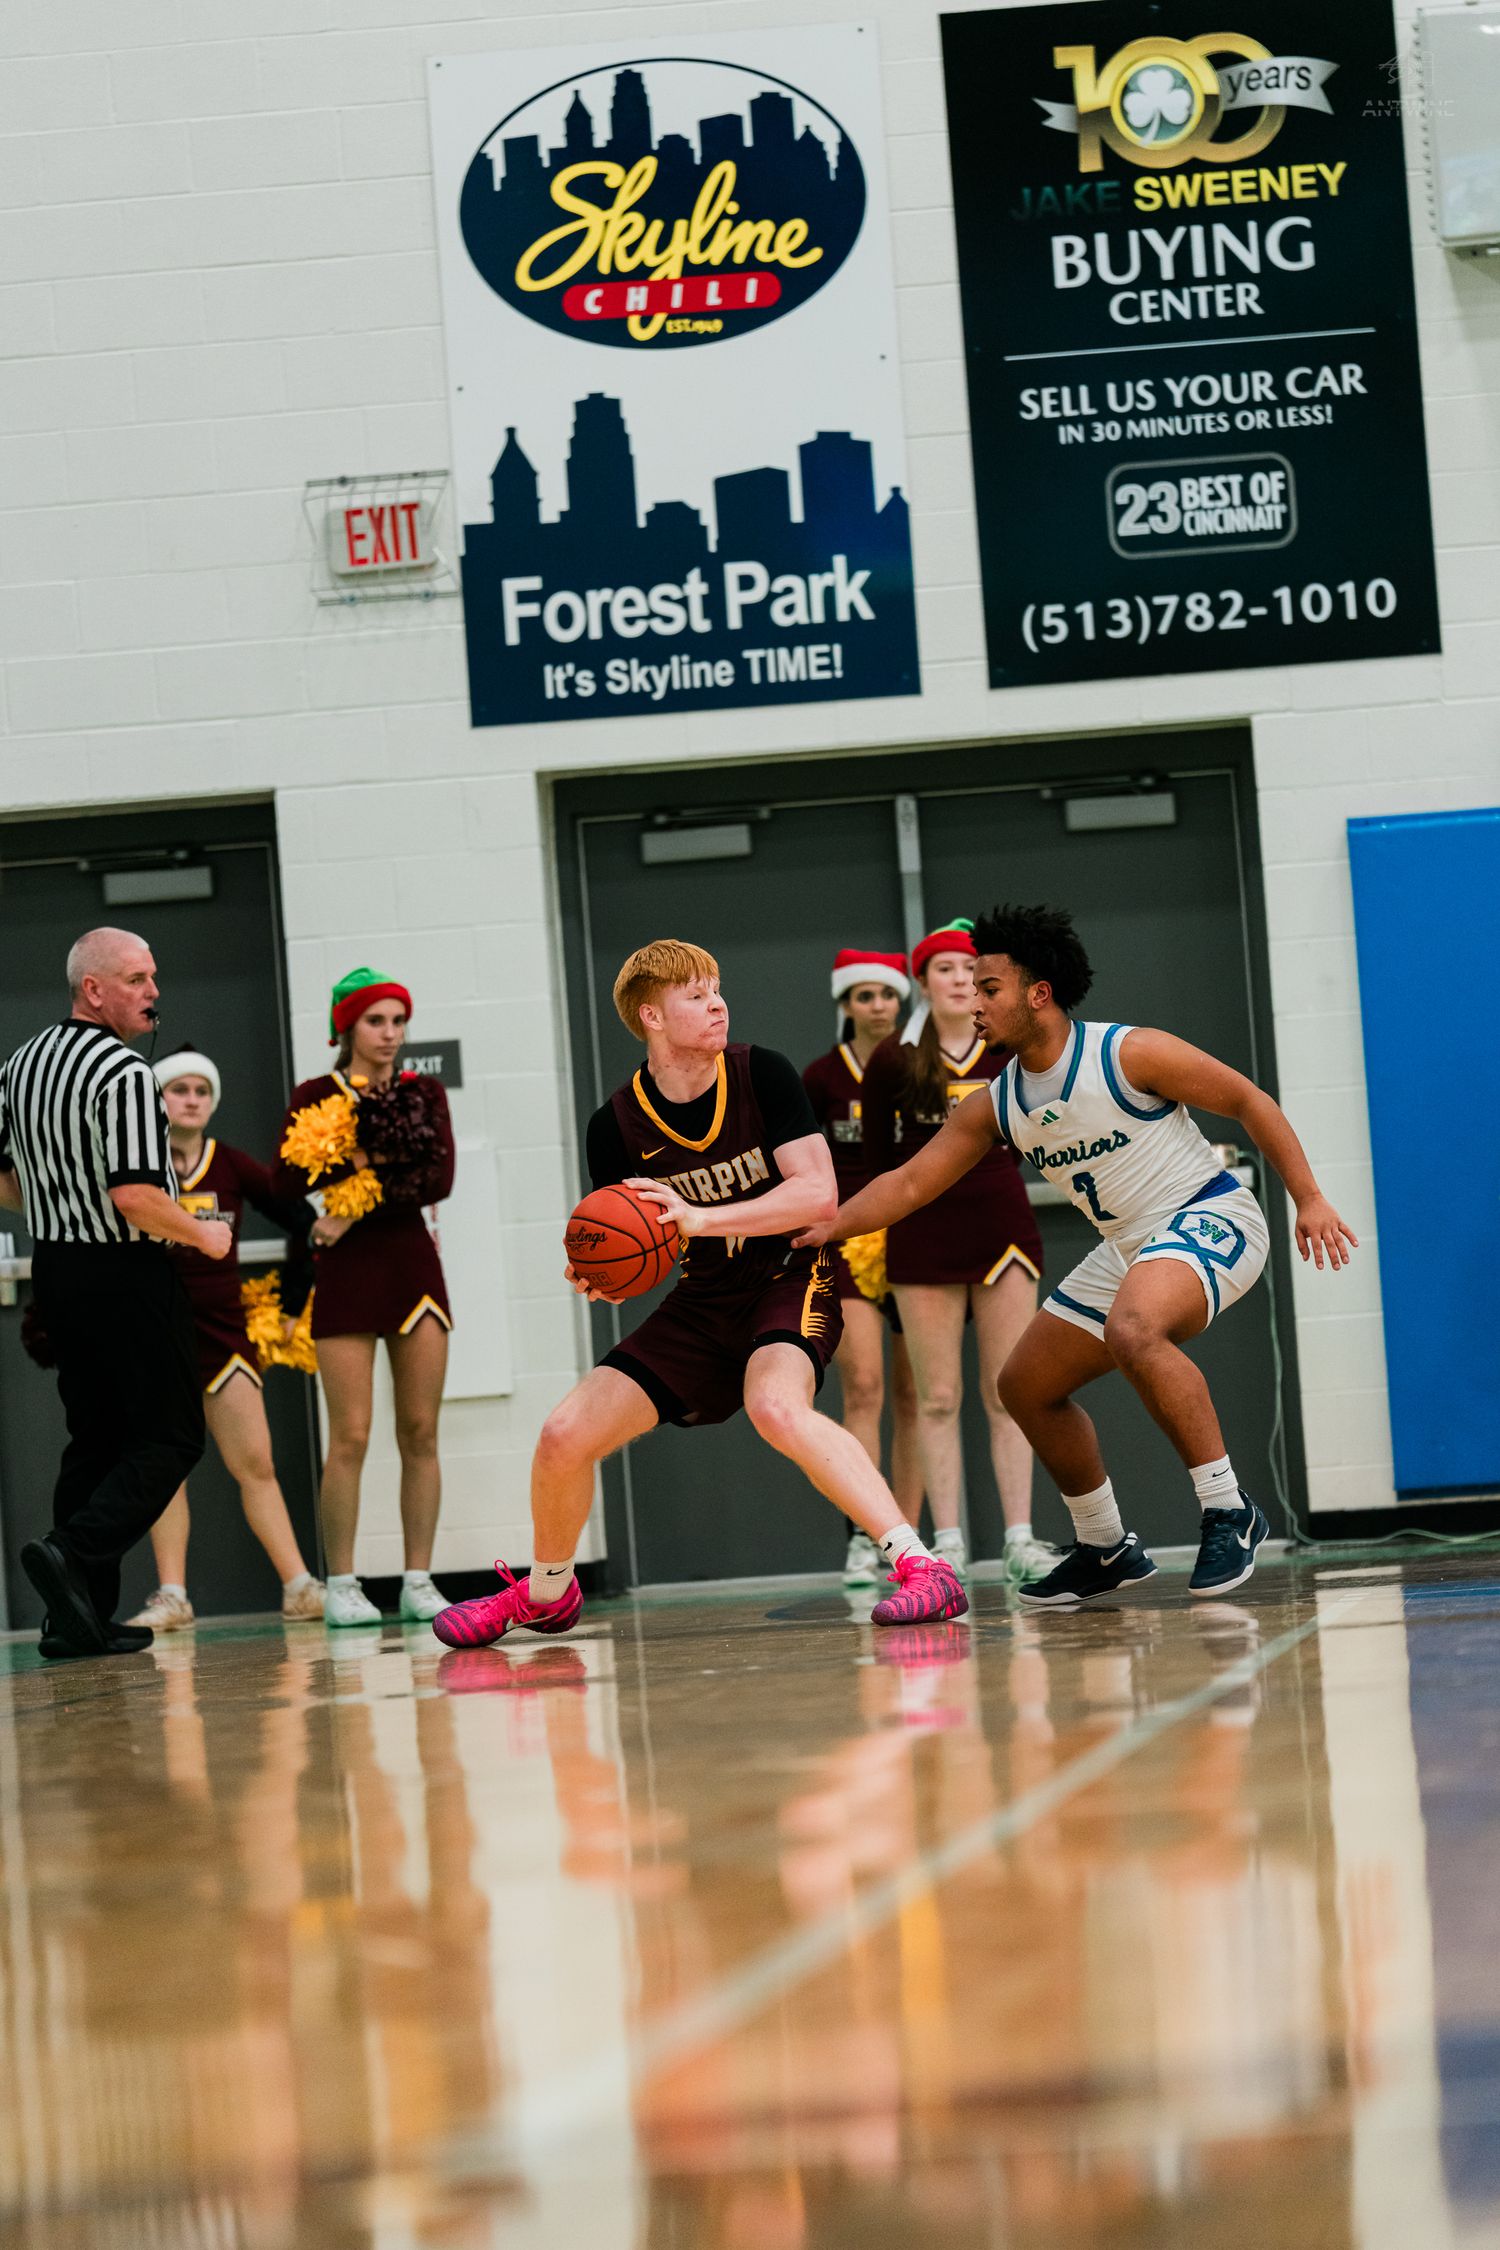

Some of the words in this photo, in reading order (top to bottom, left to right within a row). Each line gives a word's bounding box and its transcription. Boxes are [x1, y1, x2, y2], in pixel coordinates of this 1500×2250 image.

[1226, 61, 1313, 102] years
[1009, 180, 1122, 221] JAKE
[1133, 161, 1348, 212] SWEENEY
[515, 155, 824, 341] Skyline
[1050, 215, 1317, 290] BUYING
[583, 277, 759, 315] CHILI
[1109, 282, 1266, 326] CENTER
[1019, 384, 1099, 421] SELL
[1106, 379, 1157, 413] US
[1163, 370, 1279, 408] YOUR
[1285, 362, 1369, 399] CAR
[1058, 423, 1086, 445] IN
[1090, 420, 1123, 443] 30
[1126, 411, 1231, 440] MINUTES
[1234, 409, 1273, 431] OR
[1275, 403, 1334, 428] LESS!
[1115, 480, 1183, 537] 23
[1179, 474, 1244, 512] BEST
[1249, 470, 1286, 506] OF
[344, 502, 421, 568] EXIT
[502, 567, 711, 647] Forest
[723, 554, 876, 631] Park
[1021, 578, 1398, 654] (513)782-1010
[543, 662, 597, 700] It's
[605, 653, 735, 701] Skyline
[742, 643, 844, 685] TIME!
[1024, 1129, 1132, 1171] Warriors
